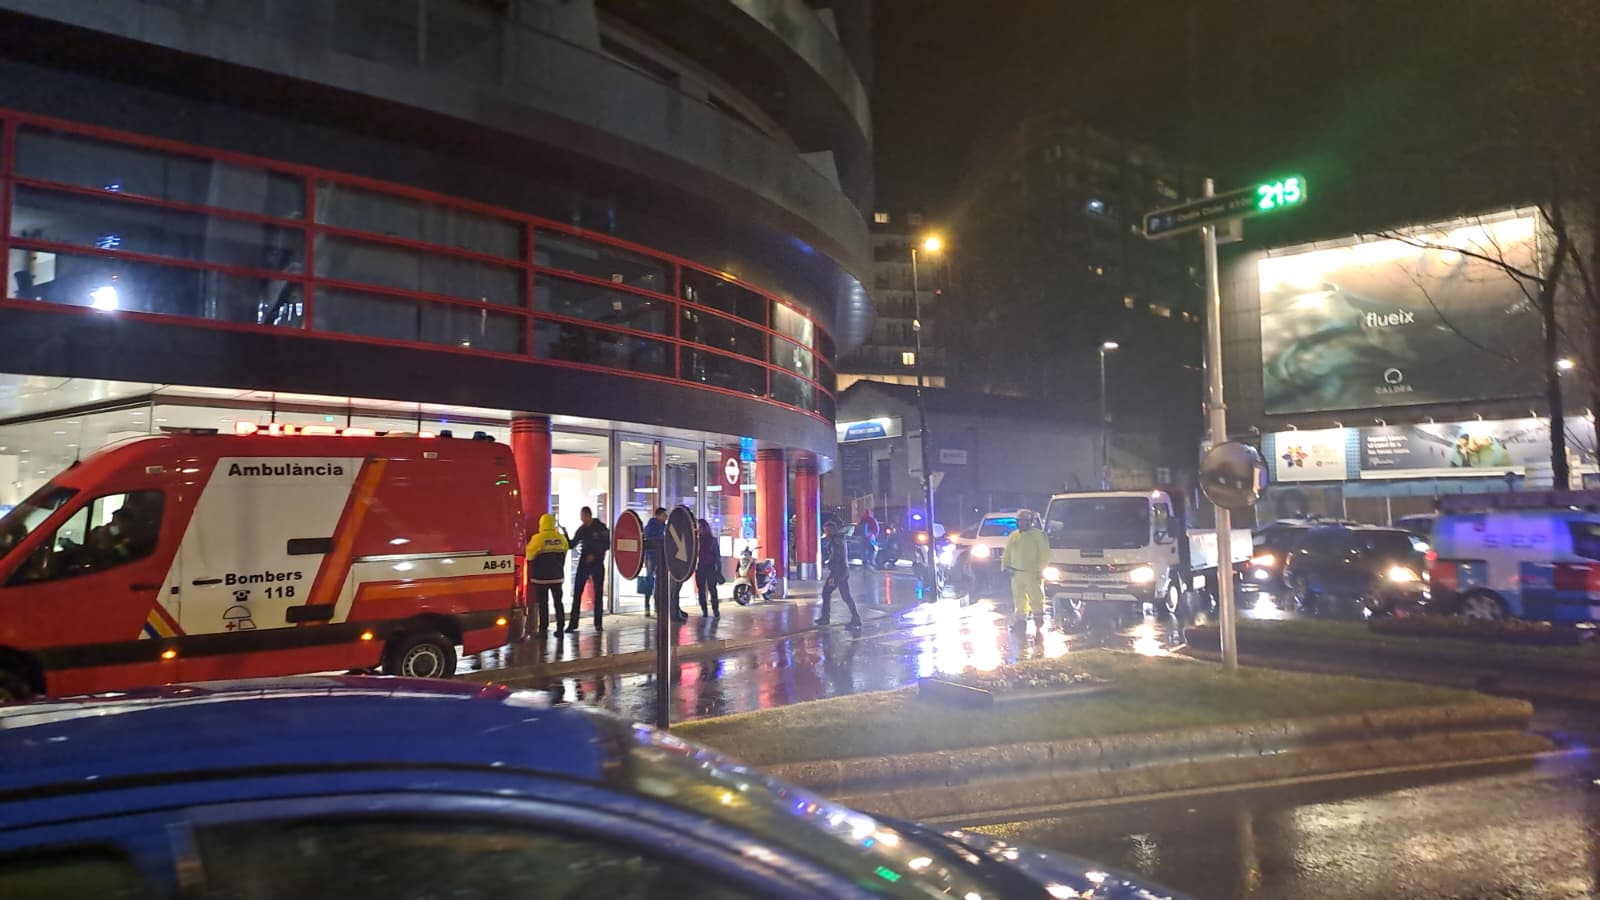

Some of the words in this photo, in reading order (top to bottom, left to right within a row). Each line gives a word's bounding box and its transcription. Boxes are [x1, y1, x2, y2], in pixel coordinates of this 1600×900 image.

[1257, 177, 1302, 209] 215
[1366, 308, 1415, 328] flueix
[228, 463, 344, 477] Ambulància
[483, 559, 512, 571] AB-61
[225, 570, 303, 586] Bombers
[264, 585, 296, 600] 118
